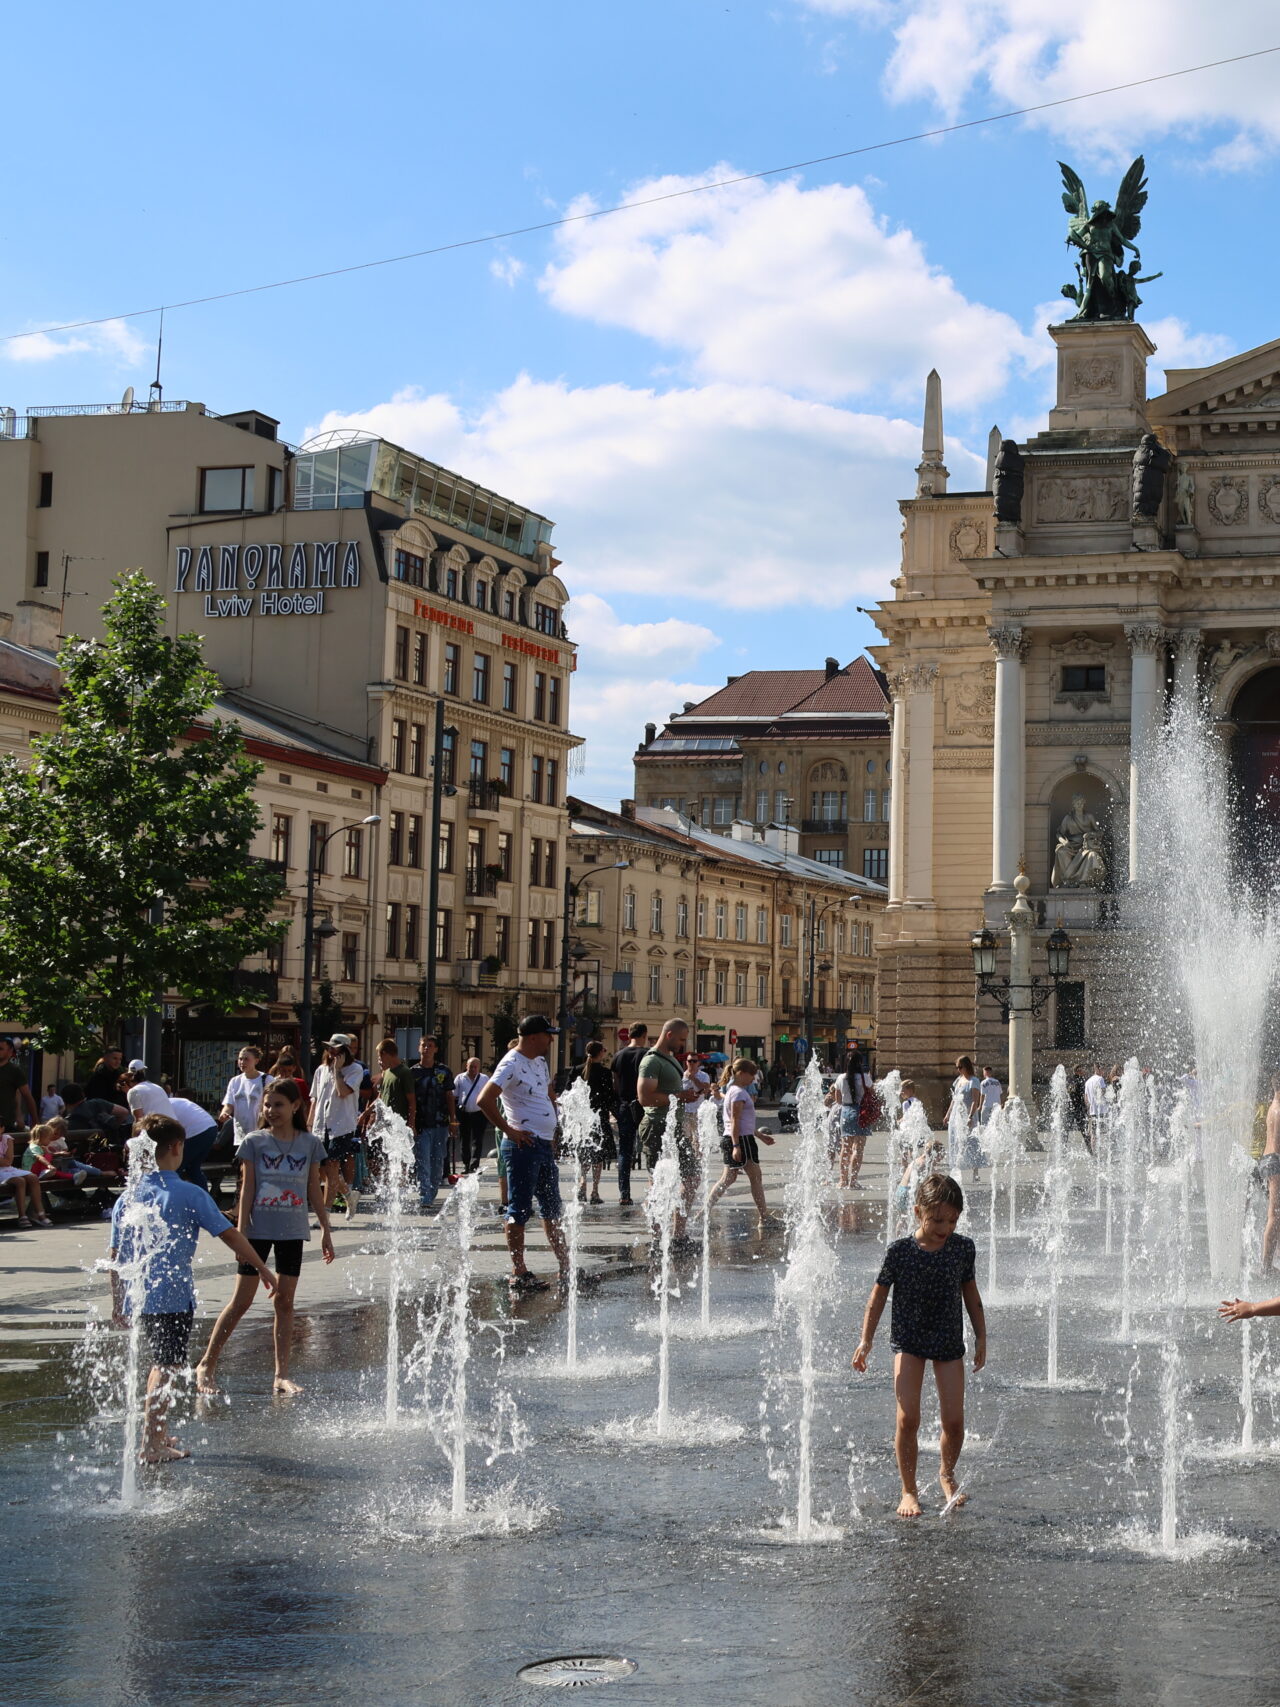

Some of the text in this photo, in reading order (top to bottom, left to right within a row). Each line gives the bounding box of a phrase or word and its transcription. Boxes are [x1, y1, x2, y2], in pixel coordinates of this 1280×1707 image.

[173, 541, 360, 592] PANORAMA
[204, 591, 324, 617] Lviv Hotel
[414, 598, 474, 635] Panorama
[501, 633, 560, 664] restaurant
